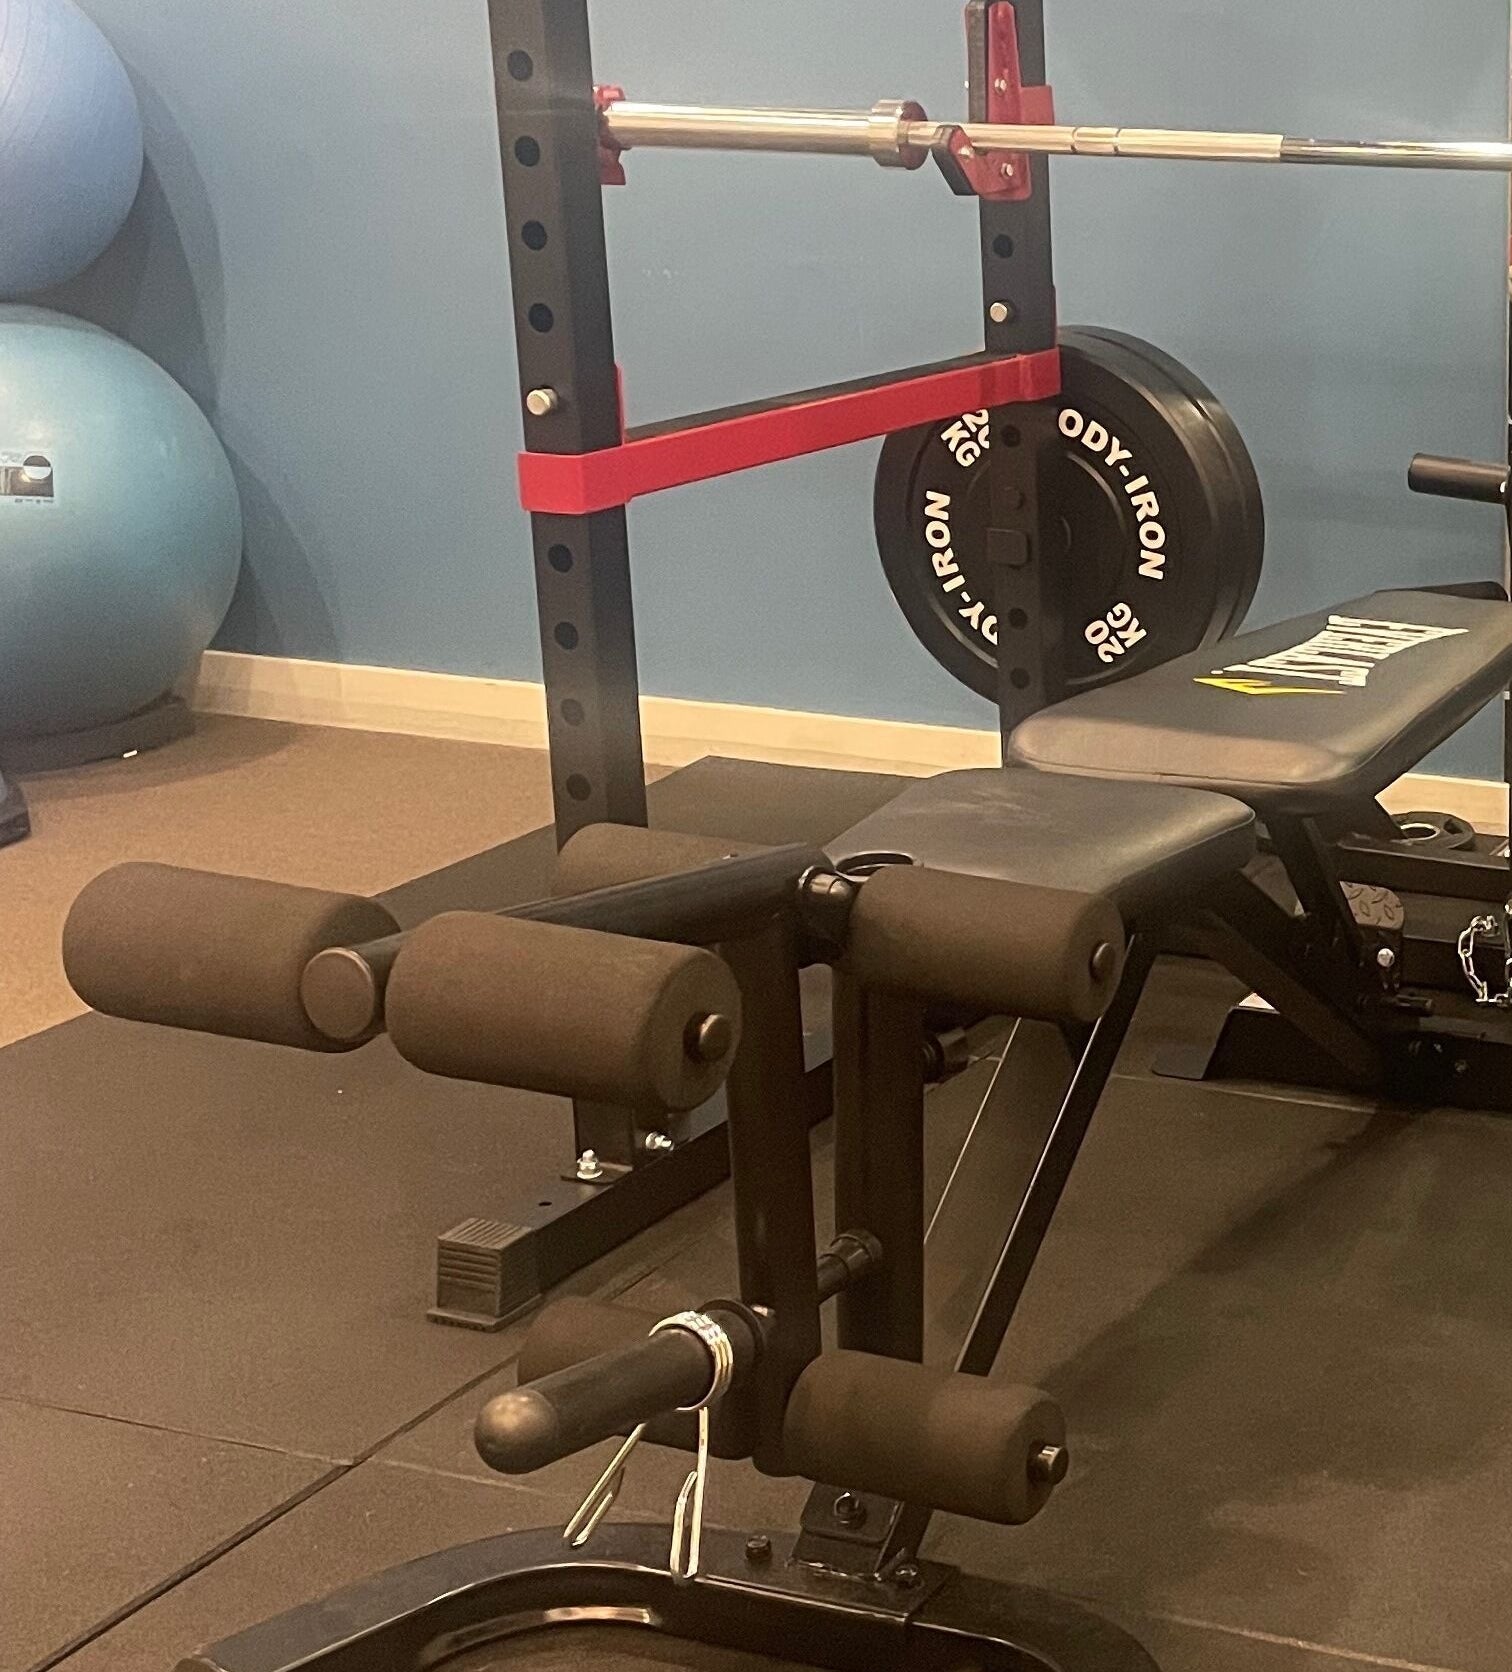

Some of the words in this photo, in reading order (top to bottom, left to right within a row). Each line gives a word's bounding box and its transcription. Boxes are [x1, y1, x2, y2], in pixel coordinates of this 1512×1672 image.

[940, 420, 981, 467] KG
[1058, 408, 1166, 580] ODY-IRON
[924, 490, 998, 646] DY-IRON
[1084, 619, 1125, 663] 20
[1106, 602, 1147, 649] KG
[1222, 614, 1470, 687] EVERLAST
